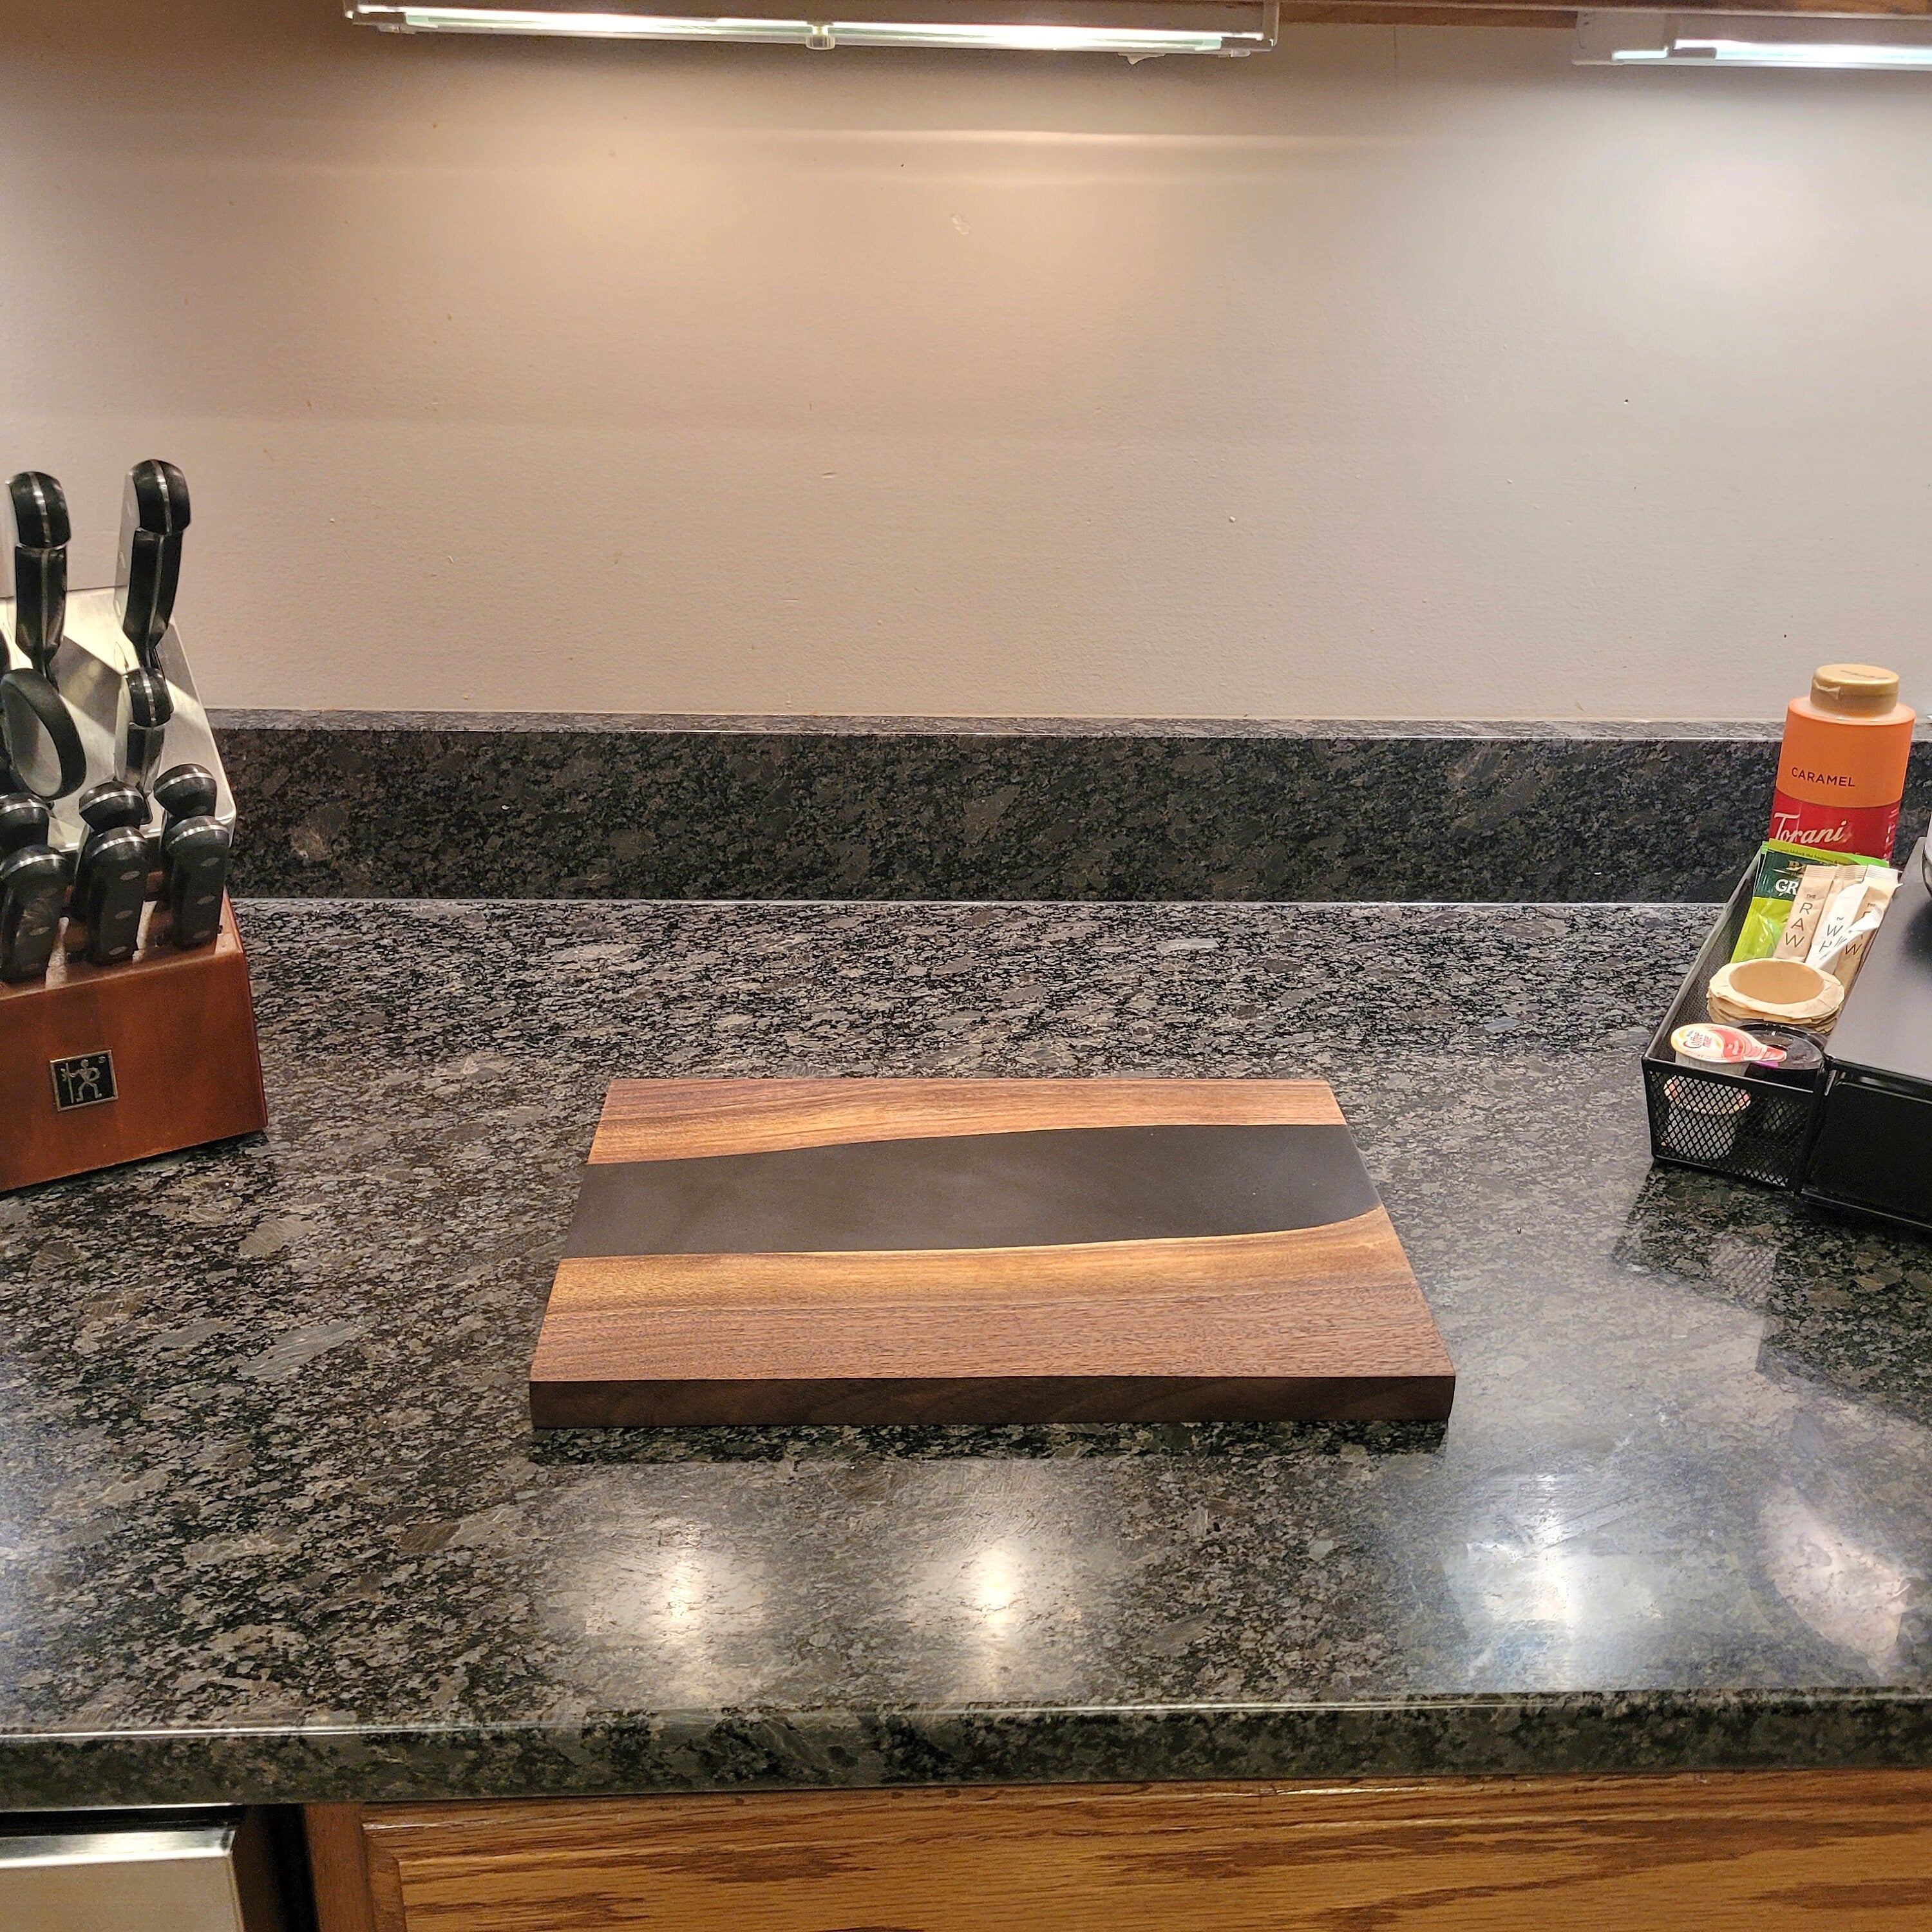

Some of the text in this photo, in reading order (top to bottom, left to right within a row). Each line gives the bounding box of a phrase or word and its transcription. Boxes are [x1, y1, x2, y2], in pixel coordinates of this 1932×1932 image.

[1791, 767, 1855, 787] CARAMEL
[1774, 812, 1847, 845] Torani
[1785, 902, 1814, 948] RAW
